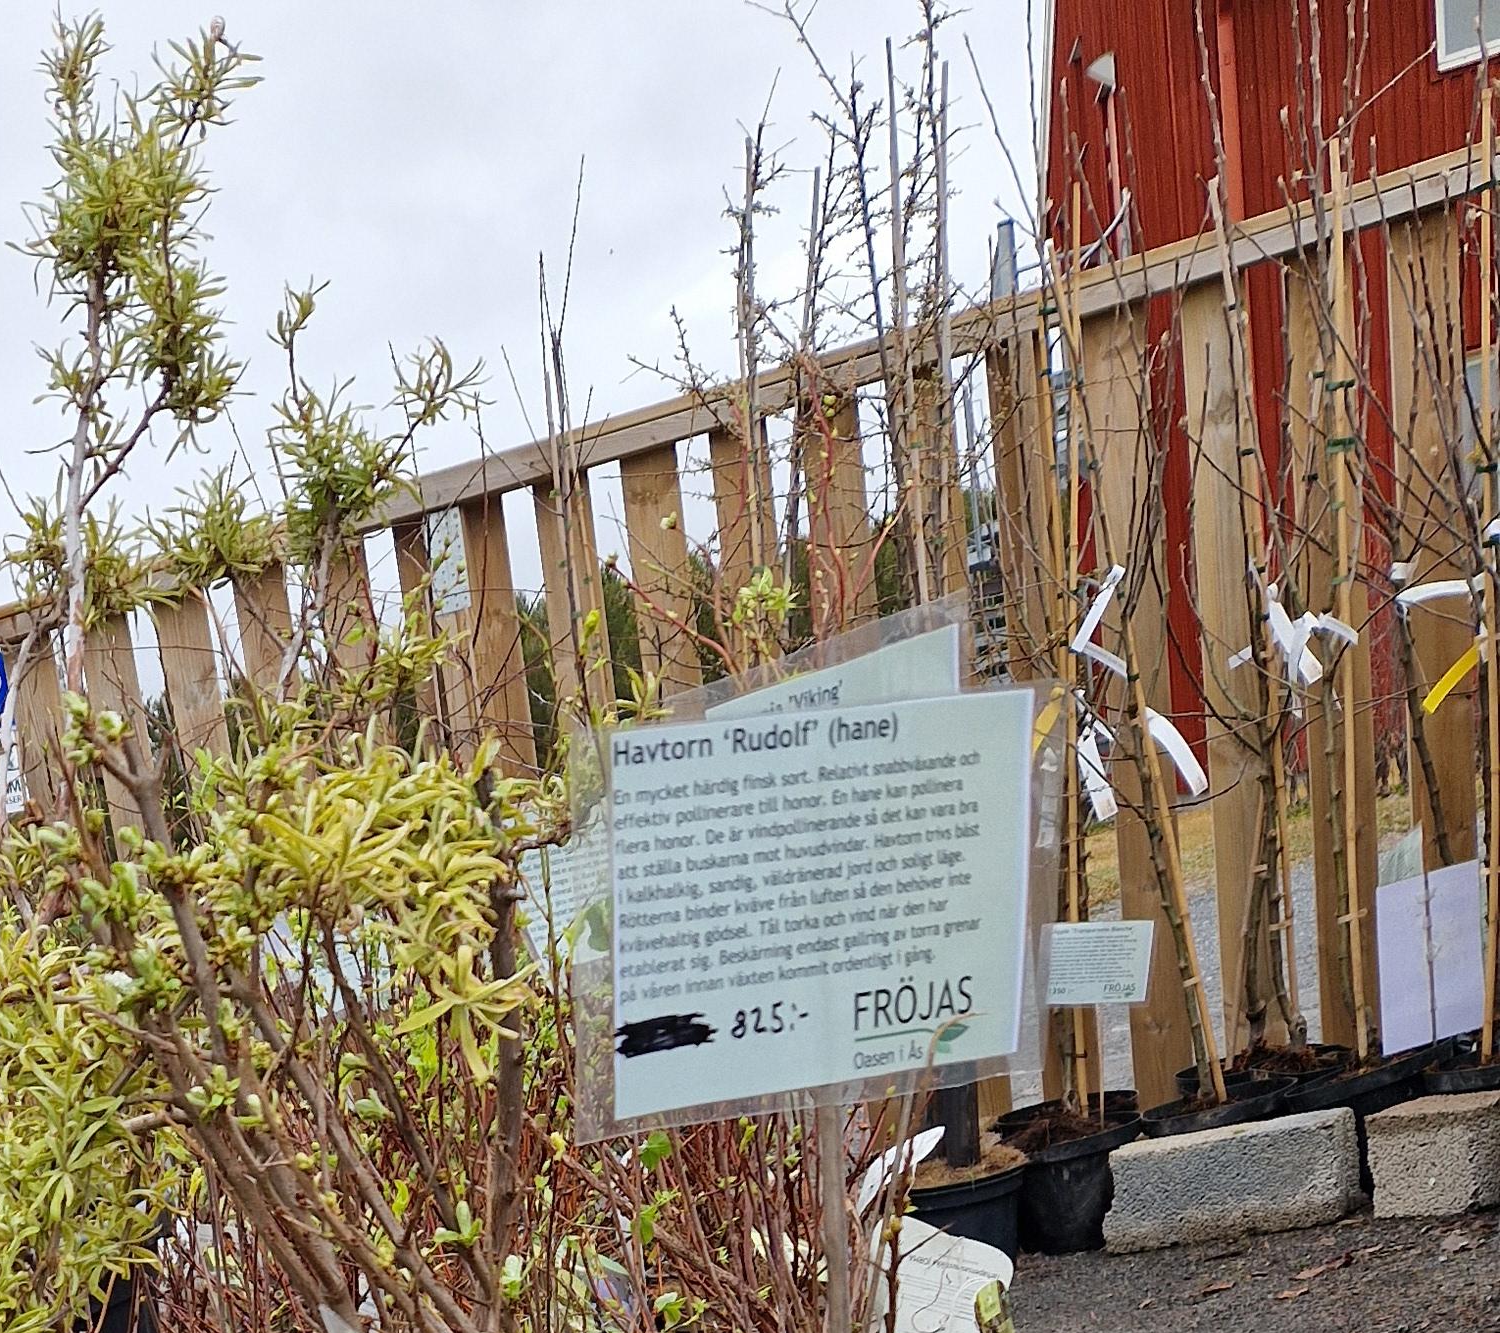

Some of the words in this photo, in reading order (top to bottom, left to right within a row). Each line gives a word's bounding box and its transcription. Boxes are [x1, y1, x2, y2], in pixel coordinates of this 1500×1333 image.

[612, 732, 713, 767] Havtorn
[723, 719, 818, 755] ‘Rudolf’
[828, 711, 899, 747] (hane)
[612, 788, 631, 806] En
[635, 780, 690, 806] mycket
[692, 776, 739, 796] härdig
[742, 770, 778, 790] finsk
[817, 760, 869, 782] Relativt
[958, 747, 981, 765] och
[613, 809, 670, 831] effektiv
[675, 803, 754, 826] pollinerare
[757, 795, 779, 813] till
[831, 788, 848, 804] En
[850, 786, 882, 802] hane
[885, 782, 907, 798] kan
[910, 776, 963, 798] pollinera
[614, 839, 650, 856] flera
[705, 828, 725, 844] De
[728, 826, 744, 842] är
[747, 811, 861, 839] vindpollinerande
[863, 808, 878, 825] så
[880, 805, 903, 822] det
[904, 804, 927, 819] kan
[929, 802, 956, 816] vara
[958, 798, 979, 813] bra
[616, 863, 639, 881] att
[642, 858, 683, 878] ställa
[685, 853, 749, 872] buskarna
[752, 845, 781, 863] mot
[873, 830, 923, 848] Havtorn
[924, 825, 952, 841] trivs
[954, 820, 980, 837] bäst
[618, 911, 681, 931] Rötterna
[684, 902, 731, 922] binder
[734, 896, 775, 915] kväve
[778, 891, 807, 909] från
[809, 886, 849, 905] luften
[852, 882, 866, 899] så
[868, 880, 893, 896] den
[895, 874, 944, 893] behöver
[947, 868, 972, 886] inte
[707, 874, 758, 894] sandig,
[761, 861, 843, 887] väldränerad
[846, 857, 872, 879] jord
[875, 854, 897, 872] och
[900, 849, 934, 869] soligt
[618, 930, 700, 956] kvävehaltig
[703, 923, 753, 947] gödsel.
[758, 918, 780, 936] Tål
[783, 914, 820, 932] torka
[822, 909, 846, 927] och
[848, 905, 876, 923] vind
[878, 902, 900, 919] när
[902, 900, 925, 916] den
[927, 897, 949, 912] har
[618, 956, 685, 980] etablerat
[718, 942, 793, 966] Beskärning
[795, 934, 840, 954] endast
[843, 928, 890, 951] gallring
[892, 928, 907, 940] av
[909, 923, 940, 938] torra
[942, 917, 981, 936] grenar
[641, 983, 680, 1001] våren
[685, 978, 724, 995] innan
[727, 968, 774, 989] växten
[777, 958, 829, 981] kommit
[831, 949, 893, 973] ordentligt
[853, 975, 974, 1031] FRÖJAS
[853, 1046, 895, 1071] Oasen
[907, 1038, 923, 1061] Ås
